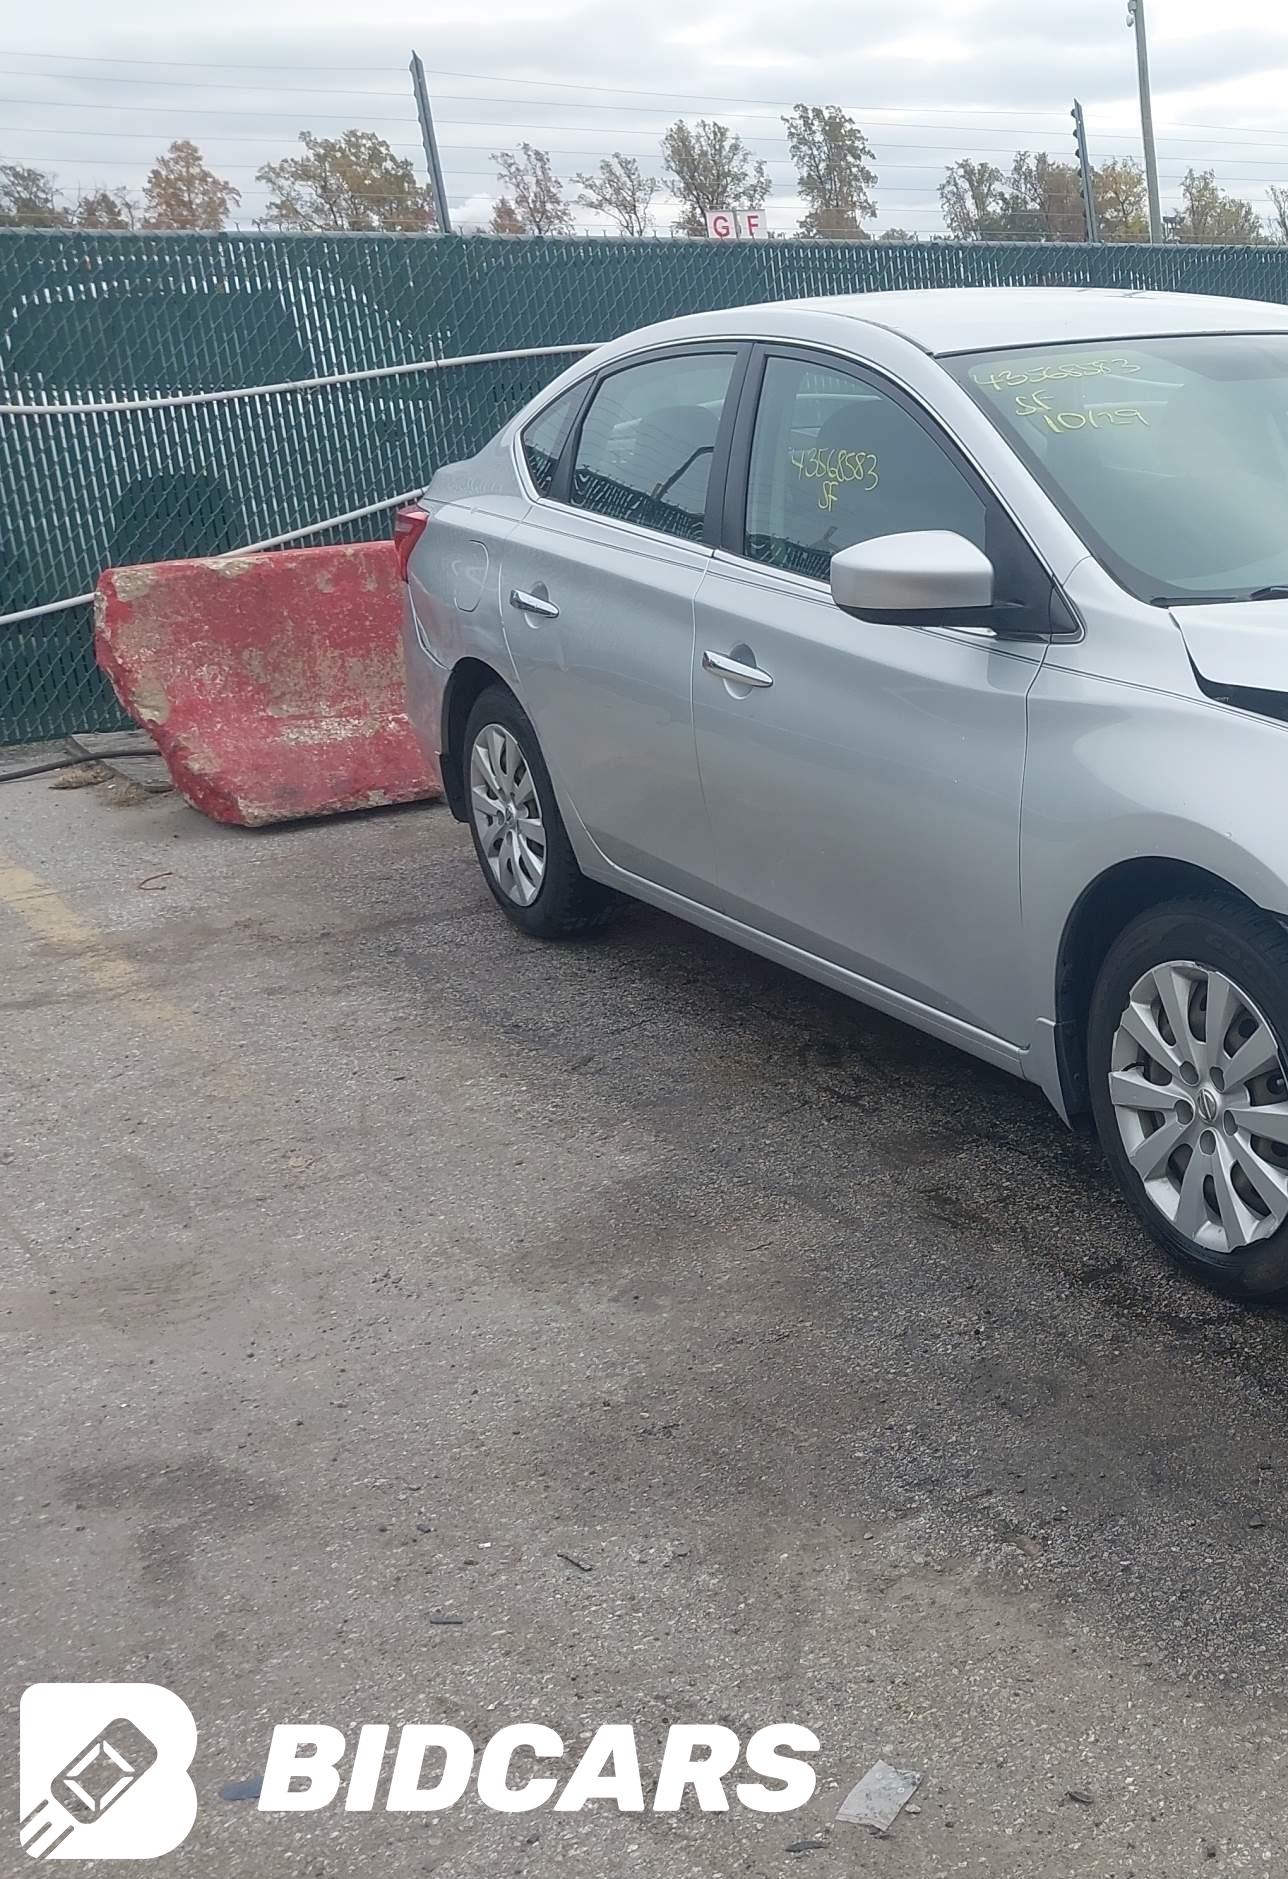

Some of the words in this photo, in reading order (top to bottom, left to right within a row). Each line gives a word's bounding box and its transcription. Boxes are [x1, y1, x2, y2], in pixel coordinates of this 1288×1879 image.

[713, 216, 730, 237] G
[747, 215, 759, 237] F
[1015, 389, 1054, 416] SF
[790, 447, 879, 491] 43568583
